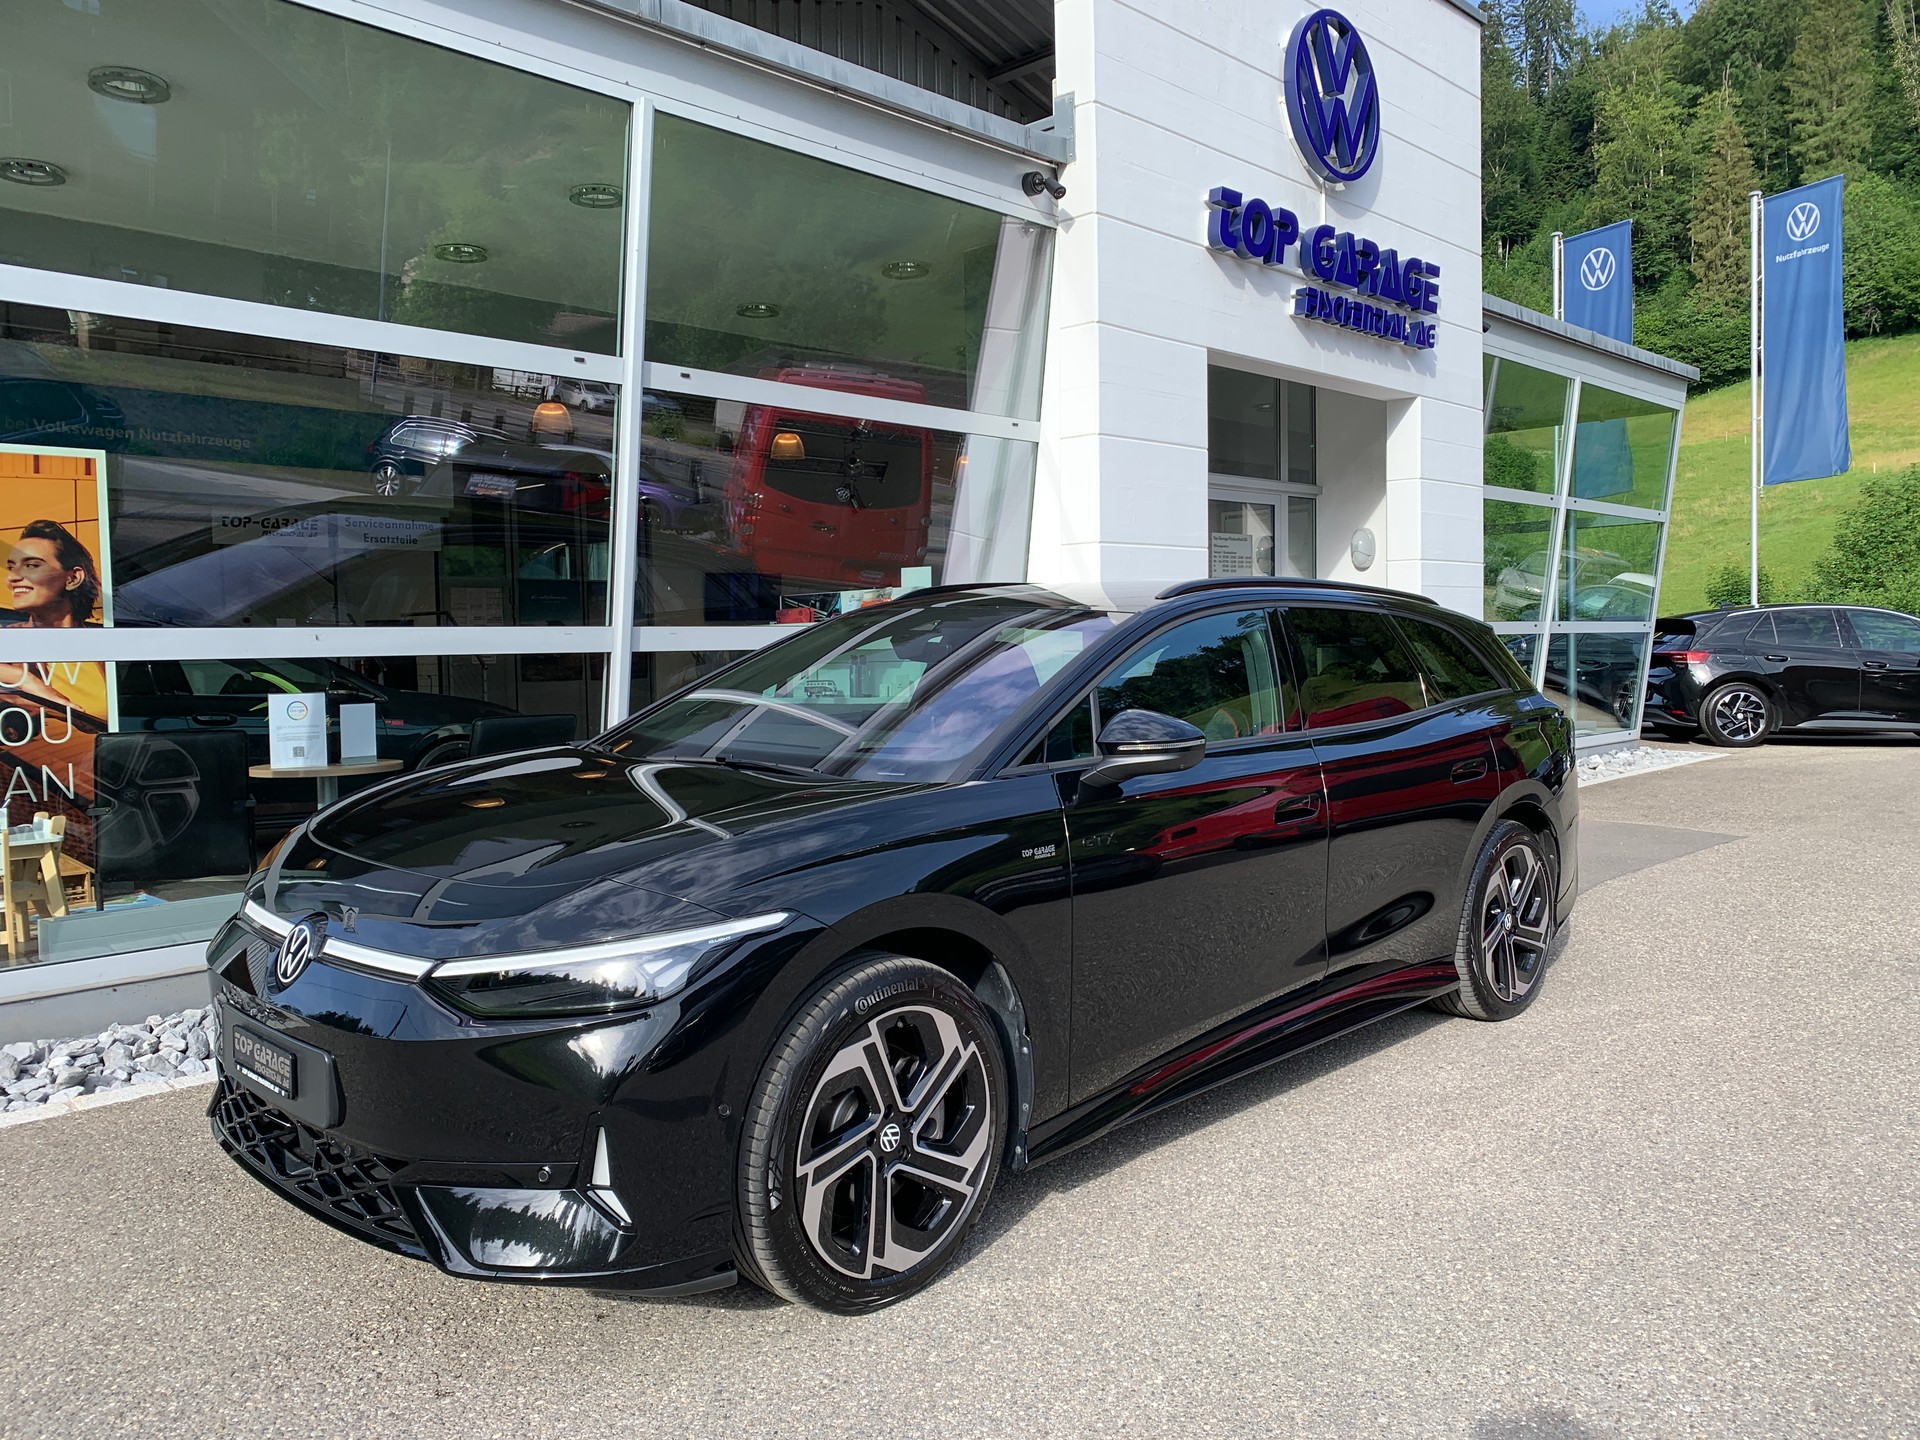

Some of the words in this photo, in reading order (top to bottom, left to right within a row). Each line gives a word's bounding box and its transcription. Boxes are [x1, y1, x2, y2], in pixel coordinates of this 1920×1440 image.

[1207, 185, 1299, 266] TOP
[1299, 224, 1441, 314] GARAGE
[1775, 242, 1830, 264] Nutzfahrzeuge
[1404, 320, 1436, 350] AG
[33, 418, 134, 440] Volkswagen
[139, 428, 251, 451] Nutzfahrzeuge
[345, 517, 435, 531] Serviceannahme
[363, 533, 419, 545] Ersatzteile
[1021, 848, 1033, 858] TOP
[1033, 844, 1056, 855] GARAGE
[855, 977, 920, 1015] Continental
[234, 1032, 253, 1056] TOP
[253, 1043, 290, 1078] GARAGE
